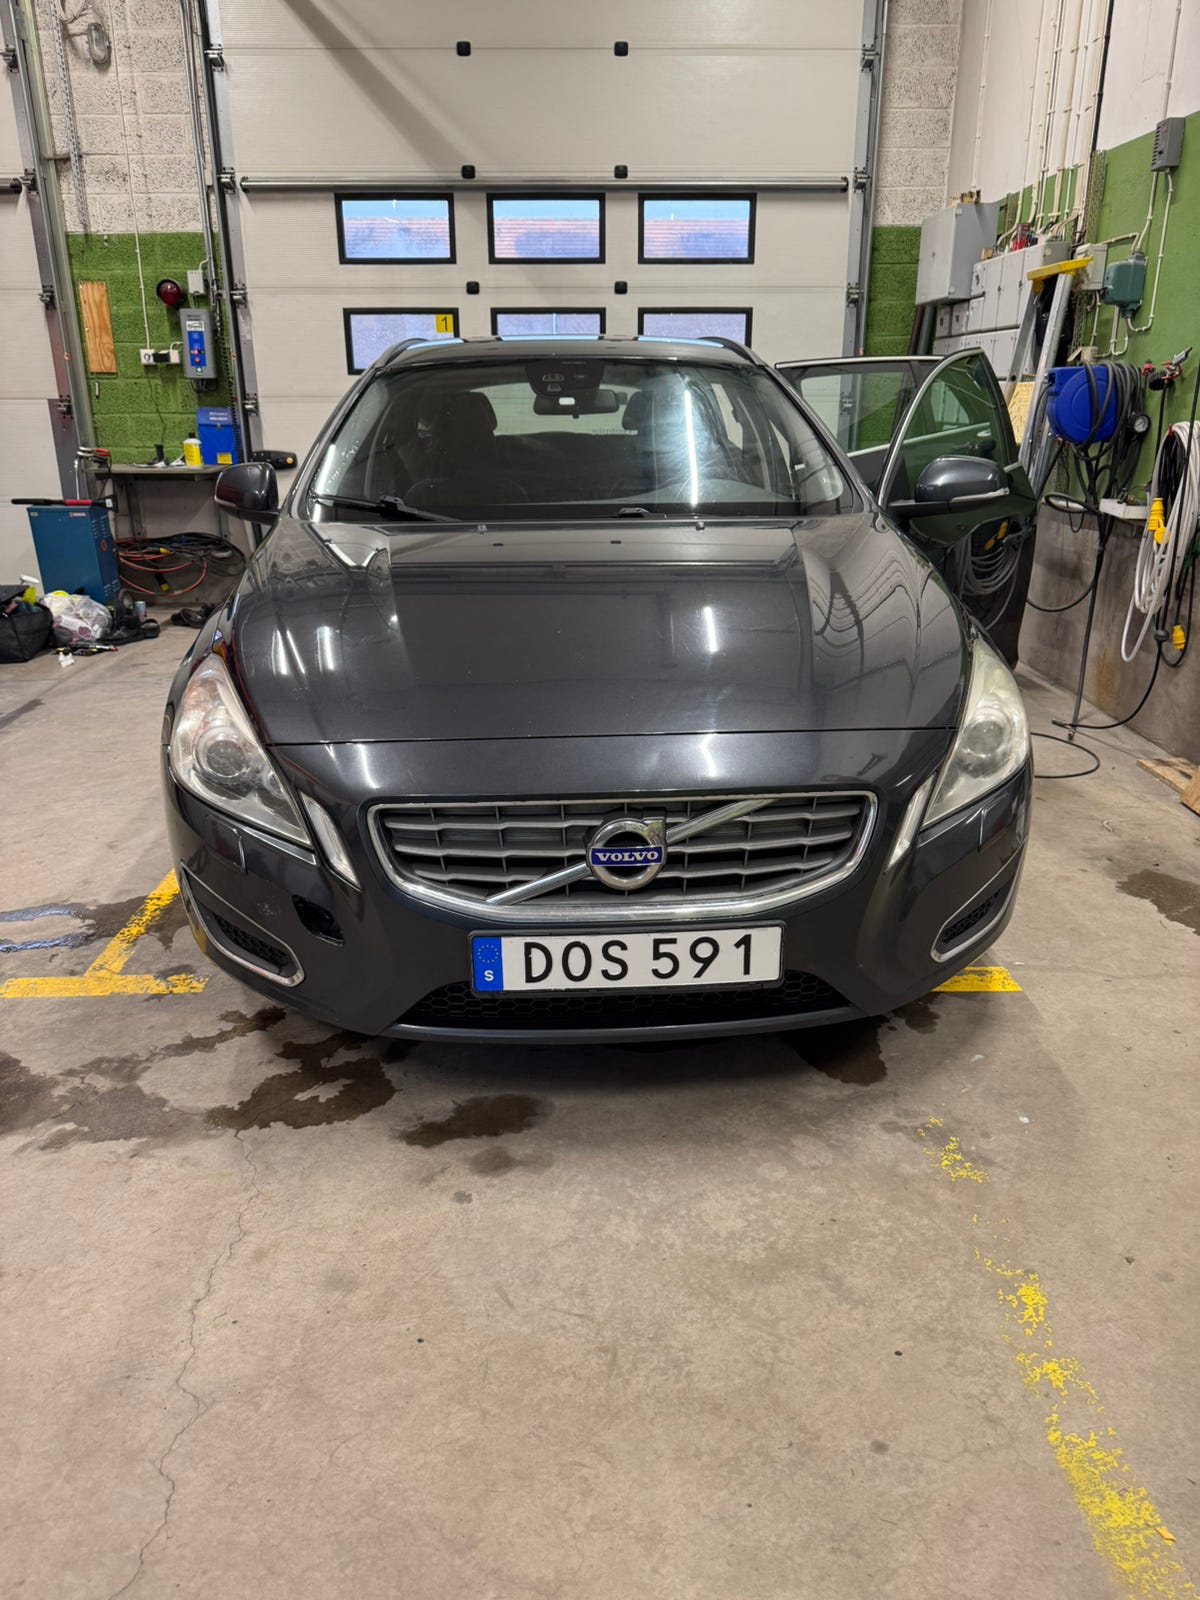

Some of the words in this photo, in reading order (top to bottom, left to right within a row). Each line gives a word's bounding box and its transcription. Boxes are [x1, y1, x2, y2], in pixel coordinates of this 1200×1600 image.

[441, 316, 448, 332] 1
[595, 851, 659, 862] VOLVO
[524, 940, 629, 983] DOS
[651, 934, 752, 979] 591
[484, 970, 494, 981] S
